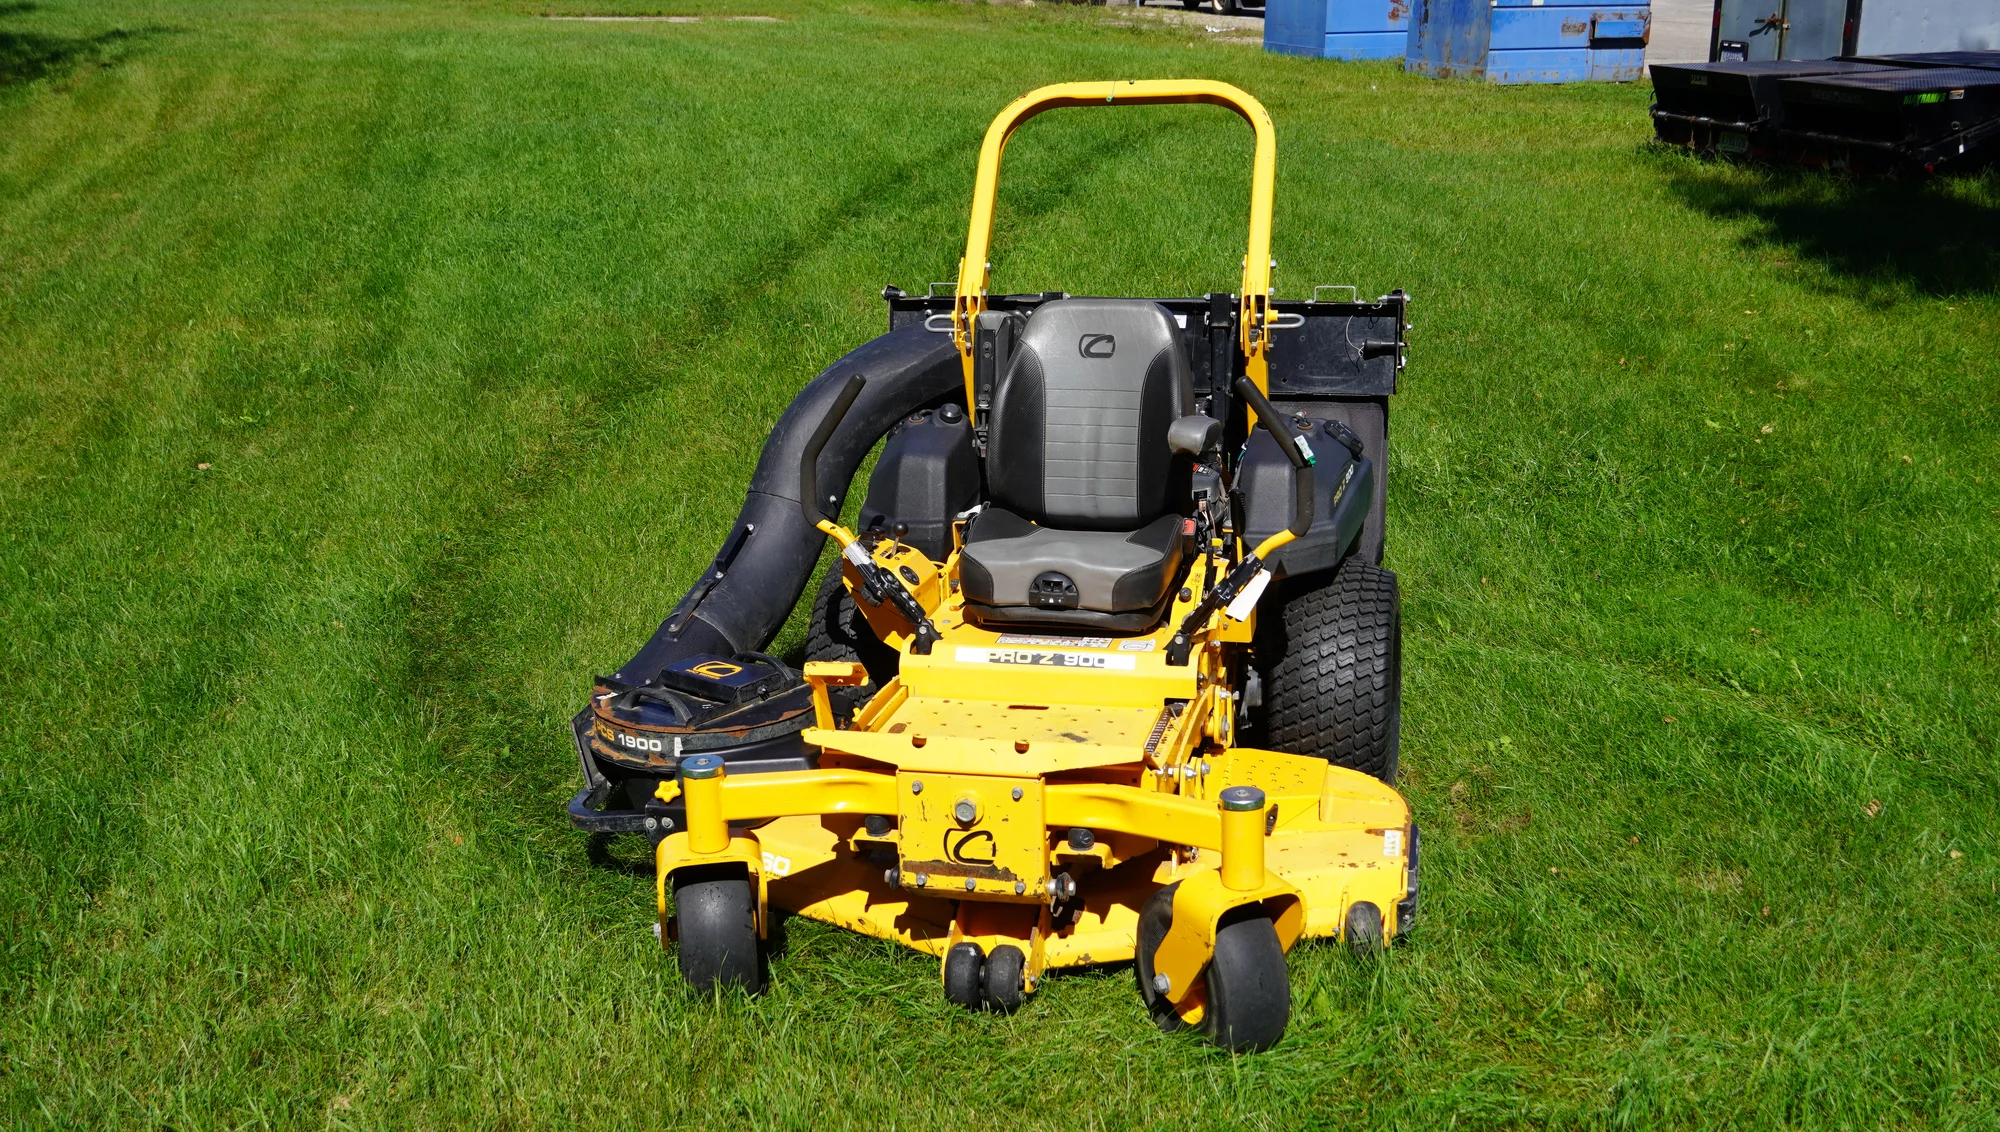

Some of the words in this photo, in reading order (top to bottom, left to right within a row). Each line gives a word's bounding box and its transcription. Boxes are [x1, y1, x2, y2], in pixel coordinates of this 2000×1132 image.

[1345, 464, 1354, 484] 900
[988, 651, 1032, 664] PRO
[1039, 653, 1054, 665] Z
[1064, 654, 1109, 668] 900
[617, 733, 662, 752] 1900
